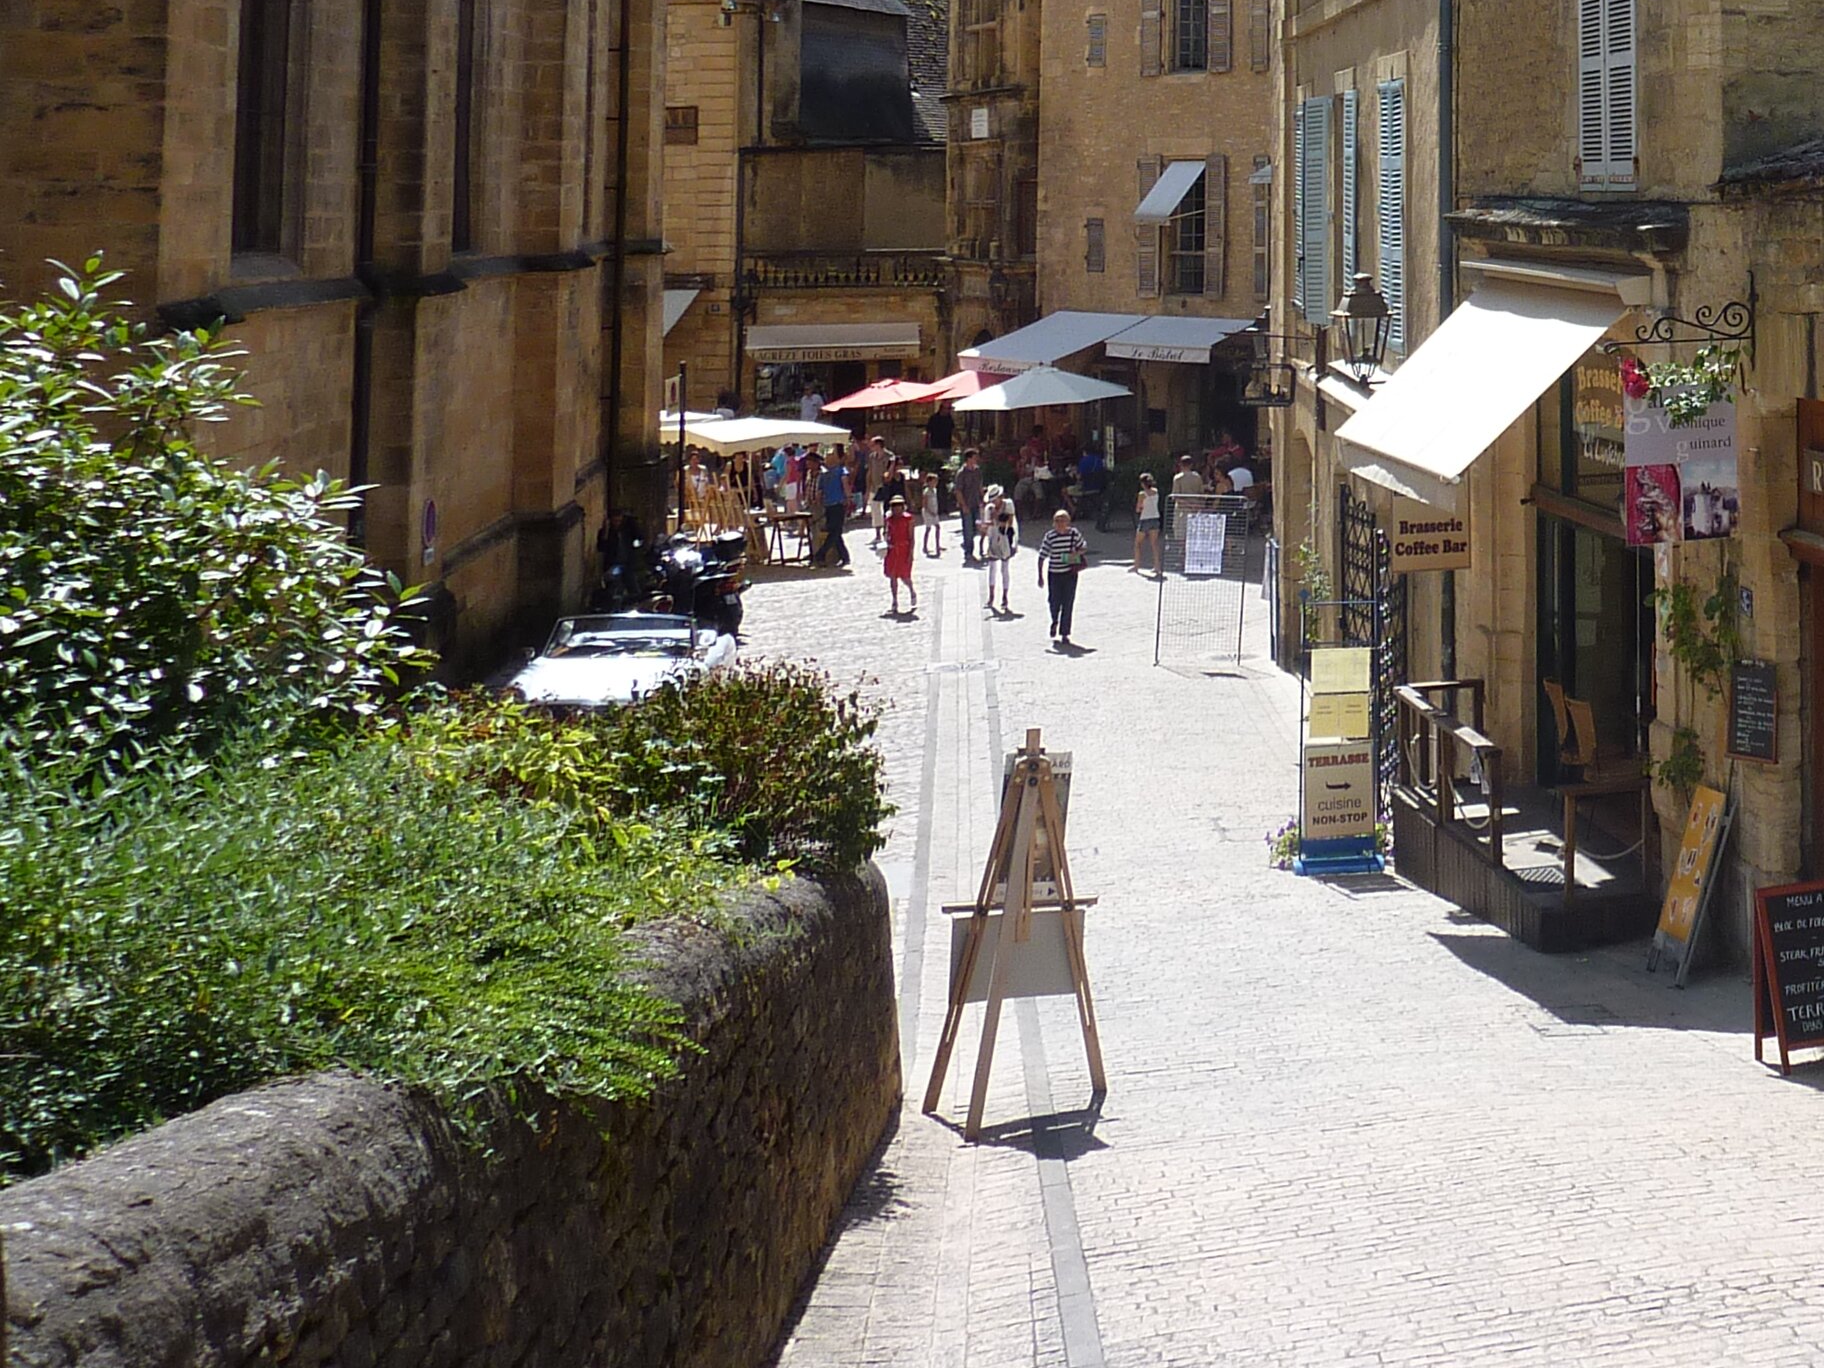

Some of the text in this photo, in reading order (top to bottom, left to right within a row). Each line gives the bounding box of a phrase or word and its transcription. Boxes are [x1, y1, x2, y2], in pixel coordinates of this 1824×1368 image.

[834, 349, 862, 359] GRAS
[1576, 365, 1623, 394] Brasser
[1676, 436, 1732, 463] guinard
[1398, 518, 1463, 535] Brasserie
[1394, 538, 1468, 557] Coffee Bar
[1307, 753, 1370, 768] TERRASSE
[1317, 796, 1362, 811] cuisine
[1312, 812, 1368, 825] NON-STOP
